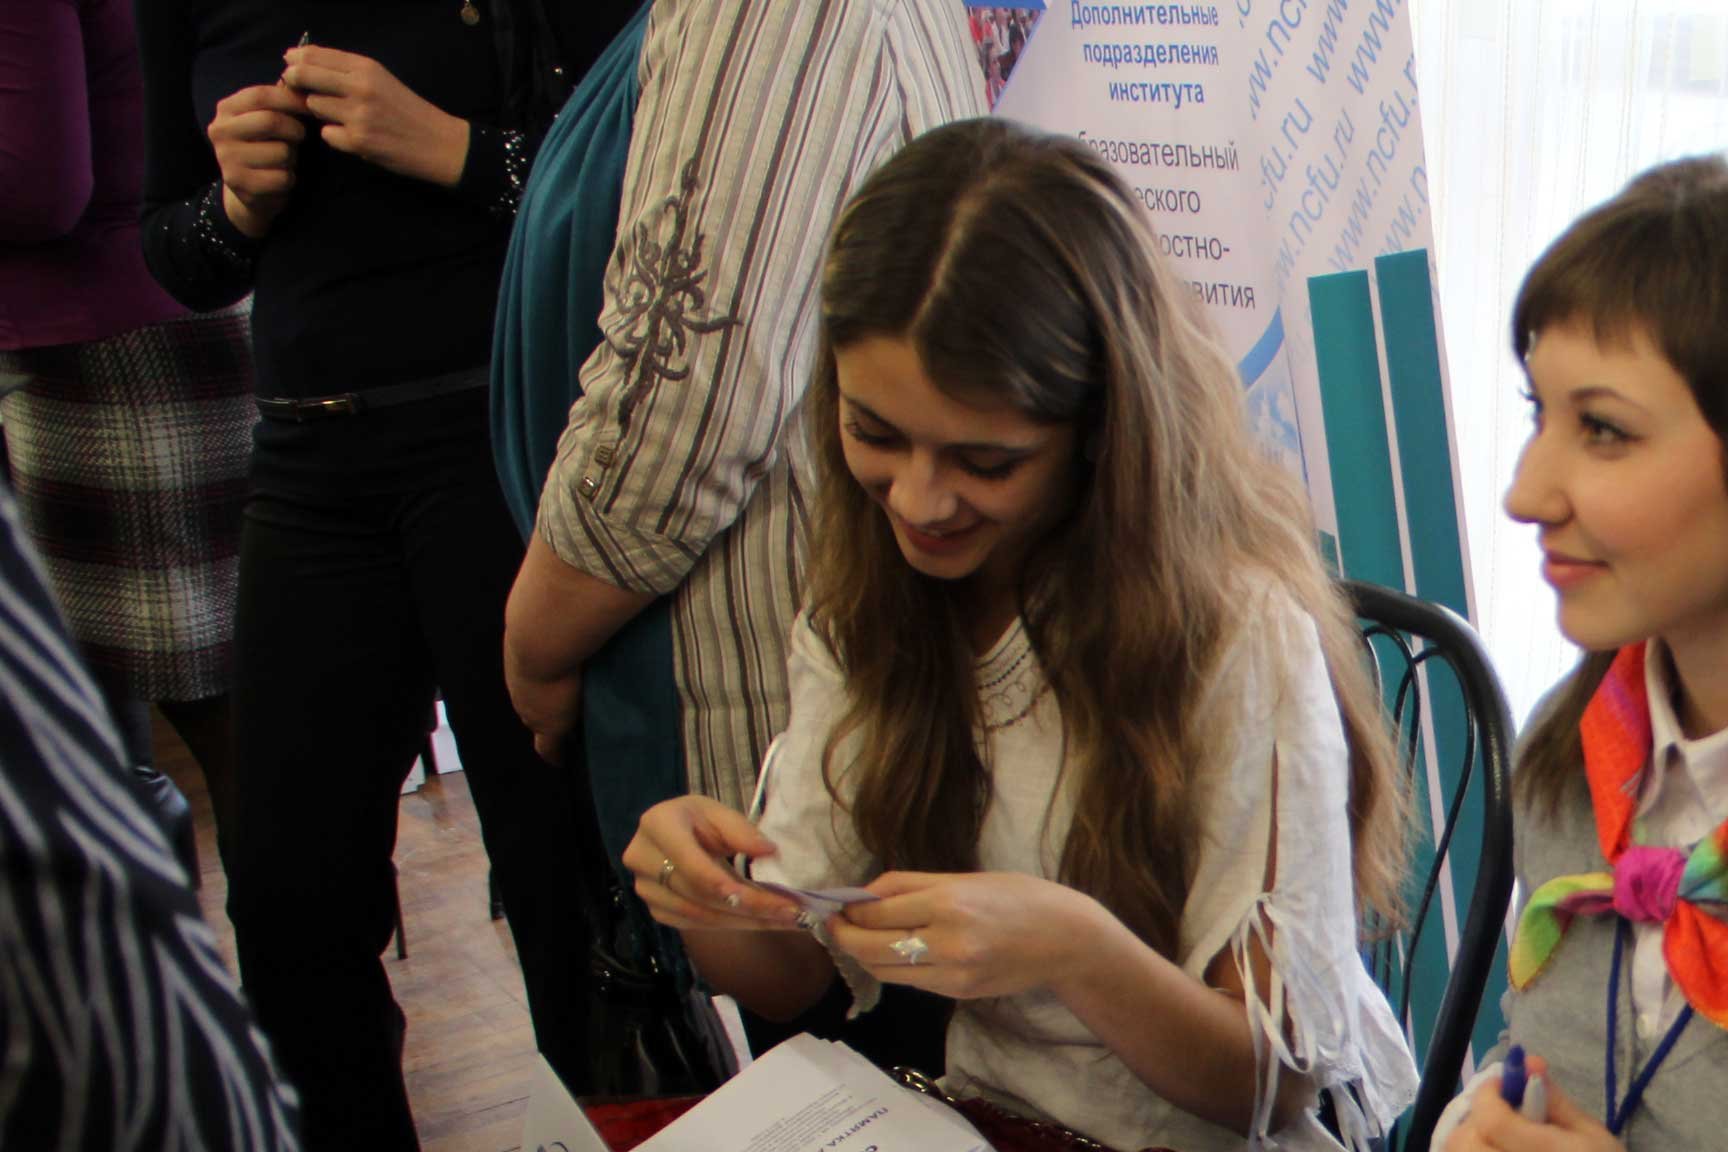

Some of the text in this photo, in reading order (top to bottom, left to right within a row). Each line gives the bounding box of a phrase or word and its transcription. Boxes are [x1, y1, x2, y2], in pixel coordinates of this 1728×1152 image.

[1071, 0, 1219, 30] Дополнительные
[1083, 43, 1219, 69] подразделения
[1108, 81, 1205, 109] института
[826, 1107, 889, 1147] ПАМЯТКА
